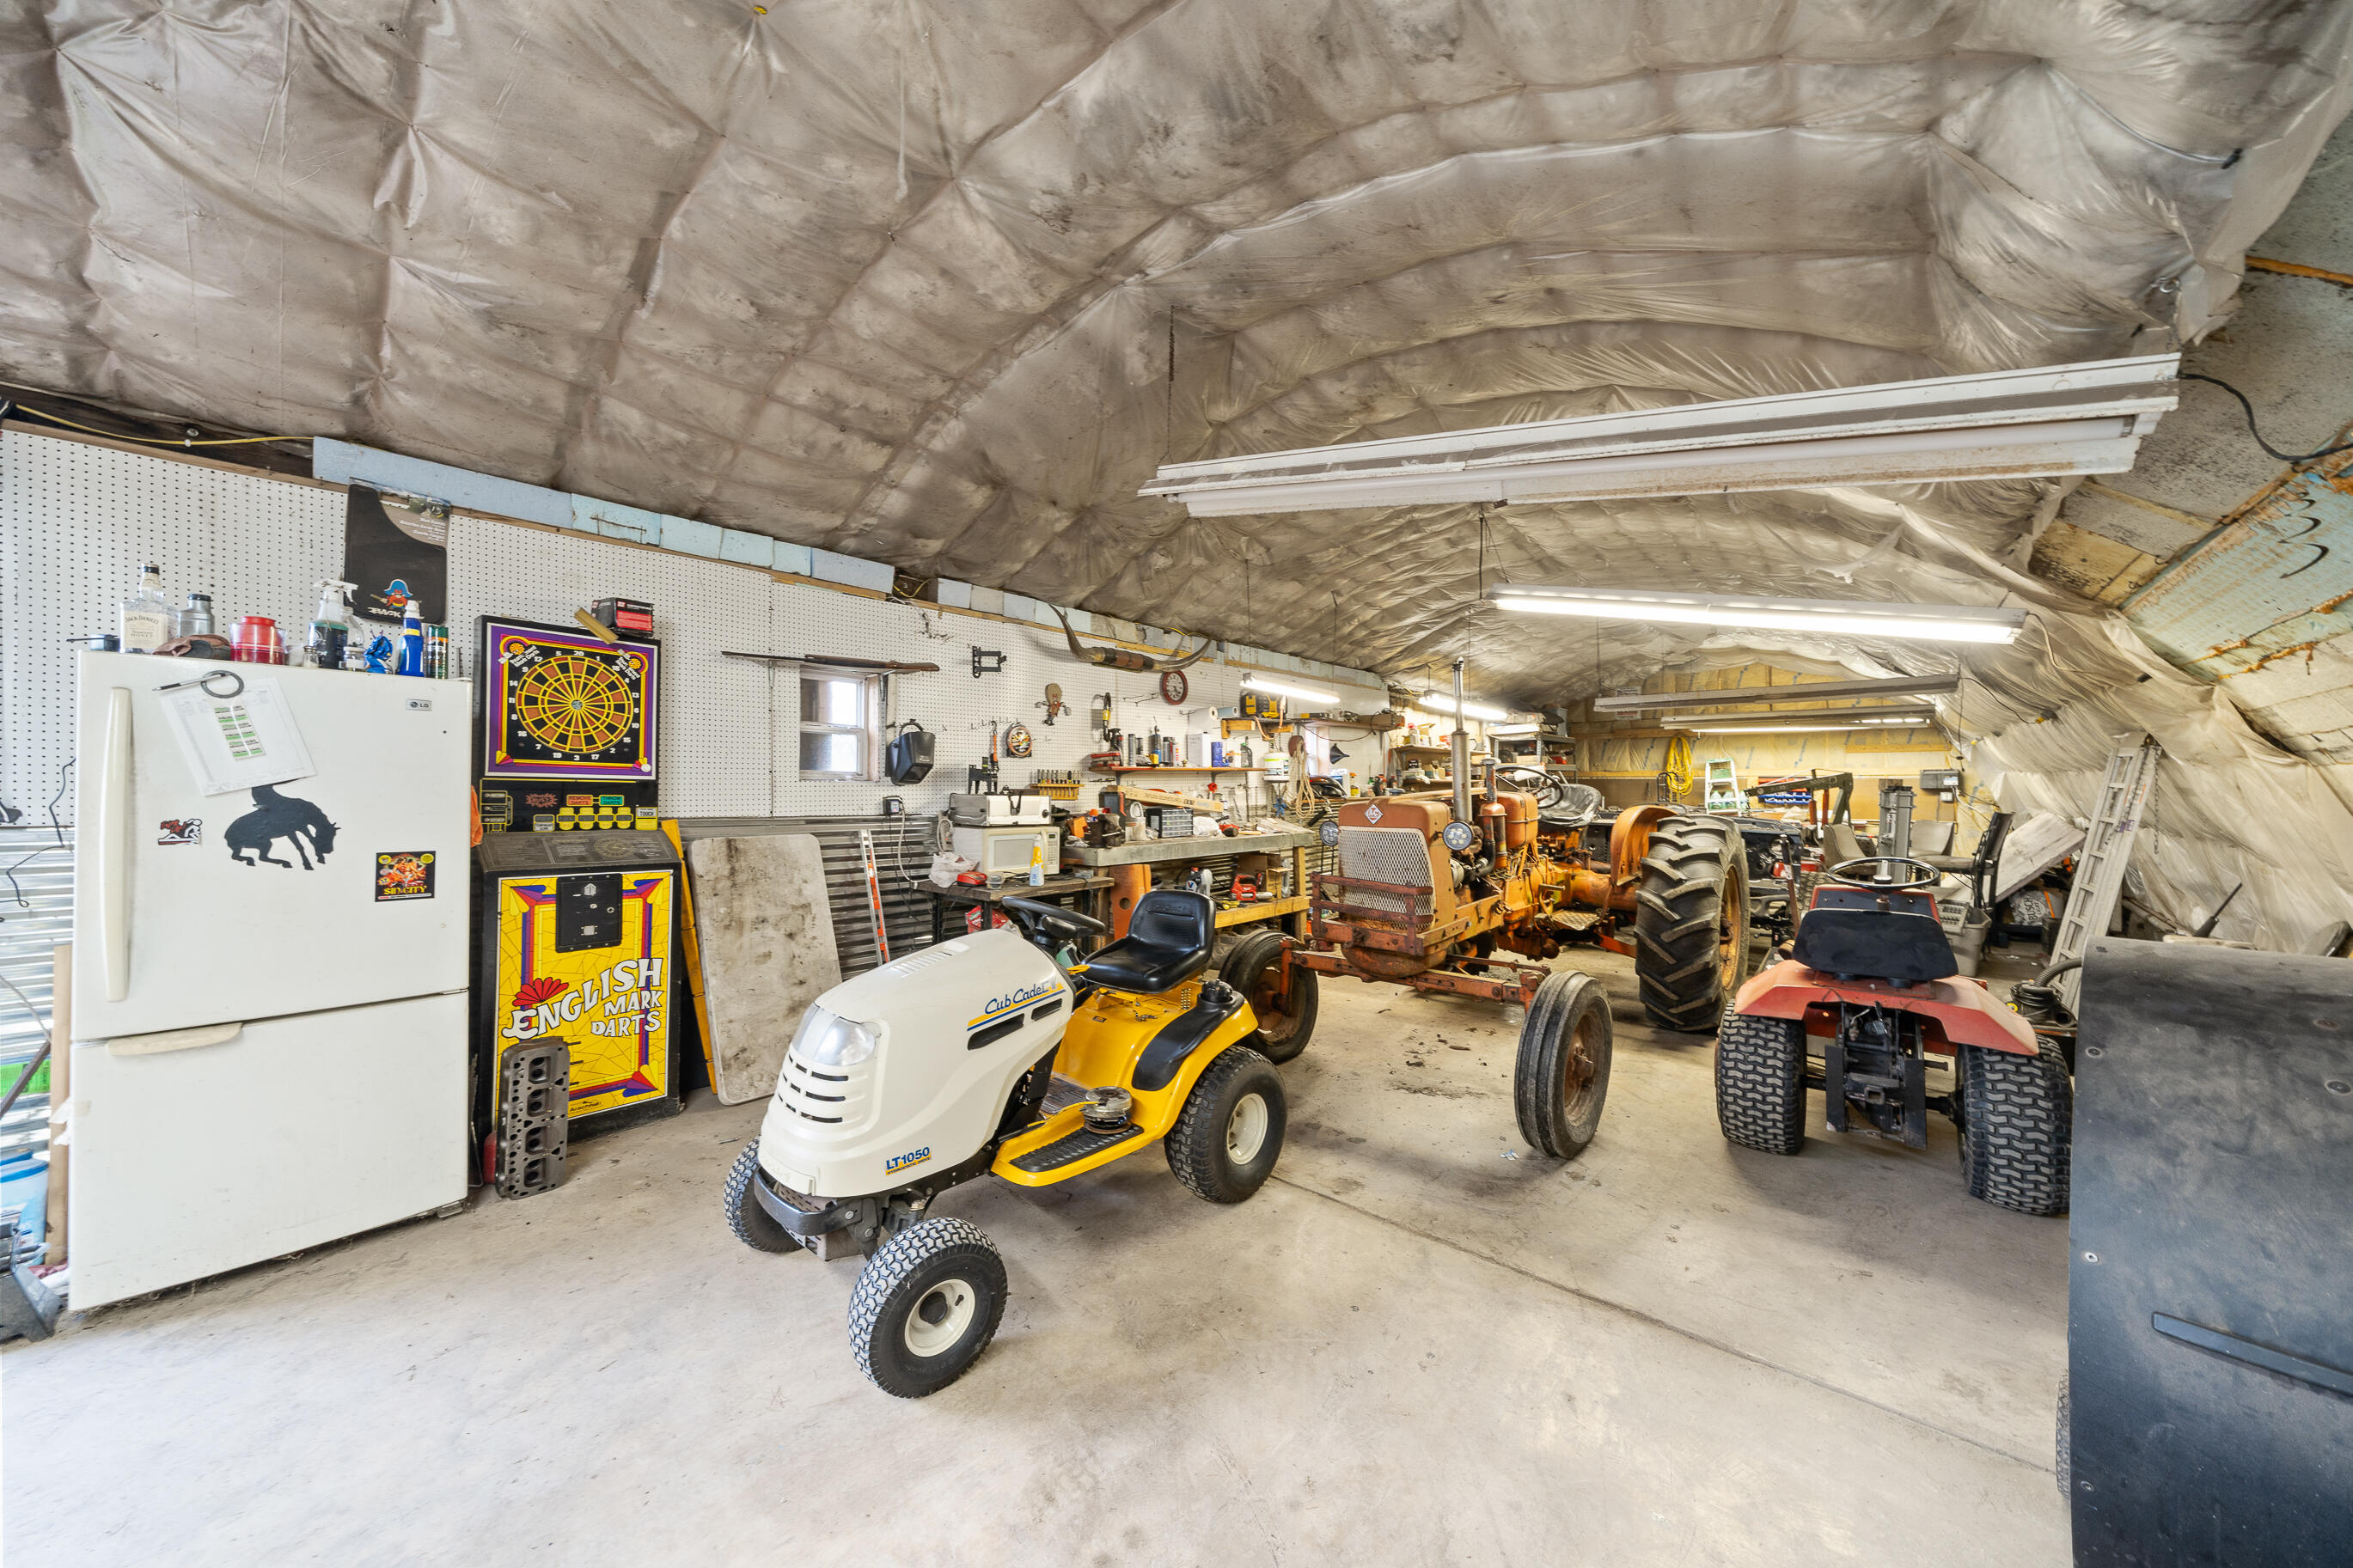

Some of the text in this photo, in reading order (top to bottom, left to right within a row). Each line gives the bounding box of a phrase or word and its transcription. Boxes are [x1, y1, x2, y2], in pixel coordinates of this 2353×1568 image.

[403, 886, 427, 894] CITY
[2023, 897, 2038, 920] BUSCH
[502, 958, 663, 1040] ENGLISH
[603, 990, 663, 1017] MARK
[984, 994, 1011, 1014] Cub
[591, 1010, 661, 1037] DARTS
[886, 1146, 930, 1170] LT1050
